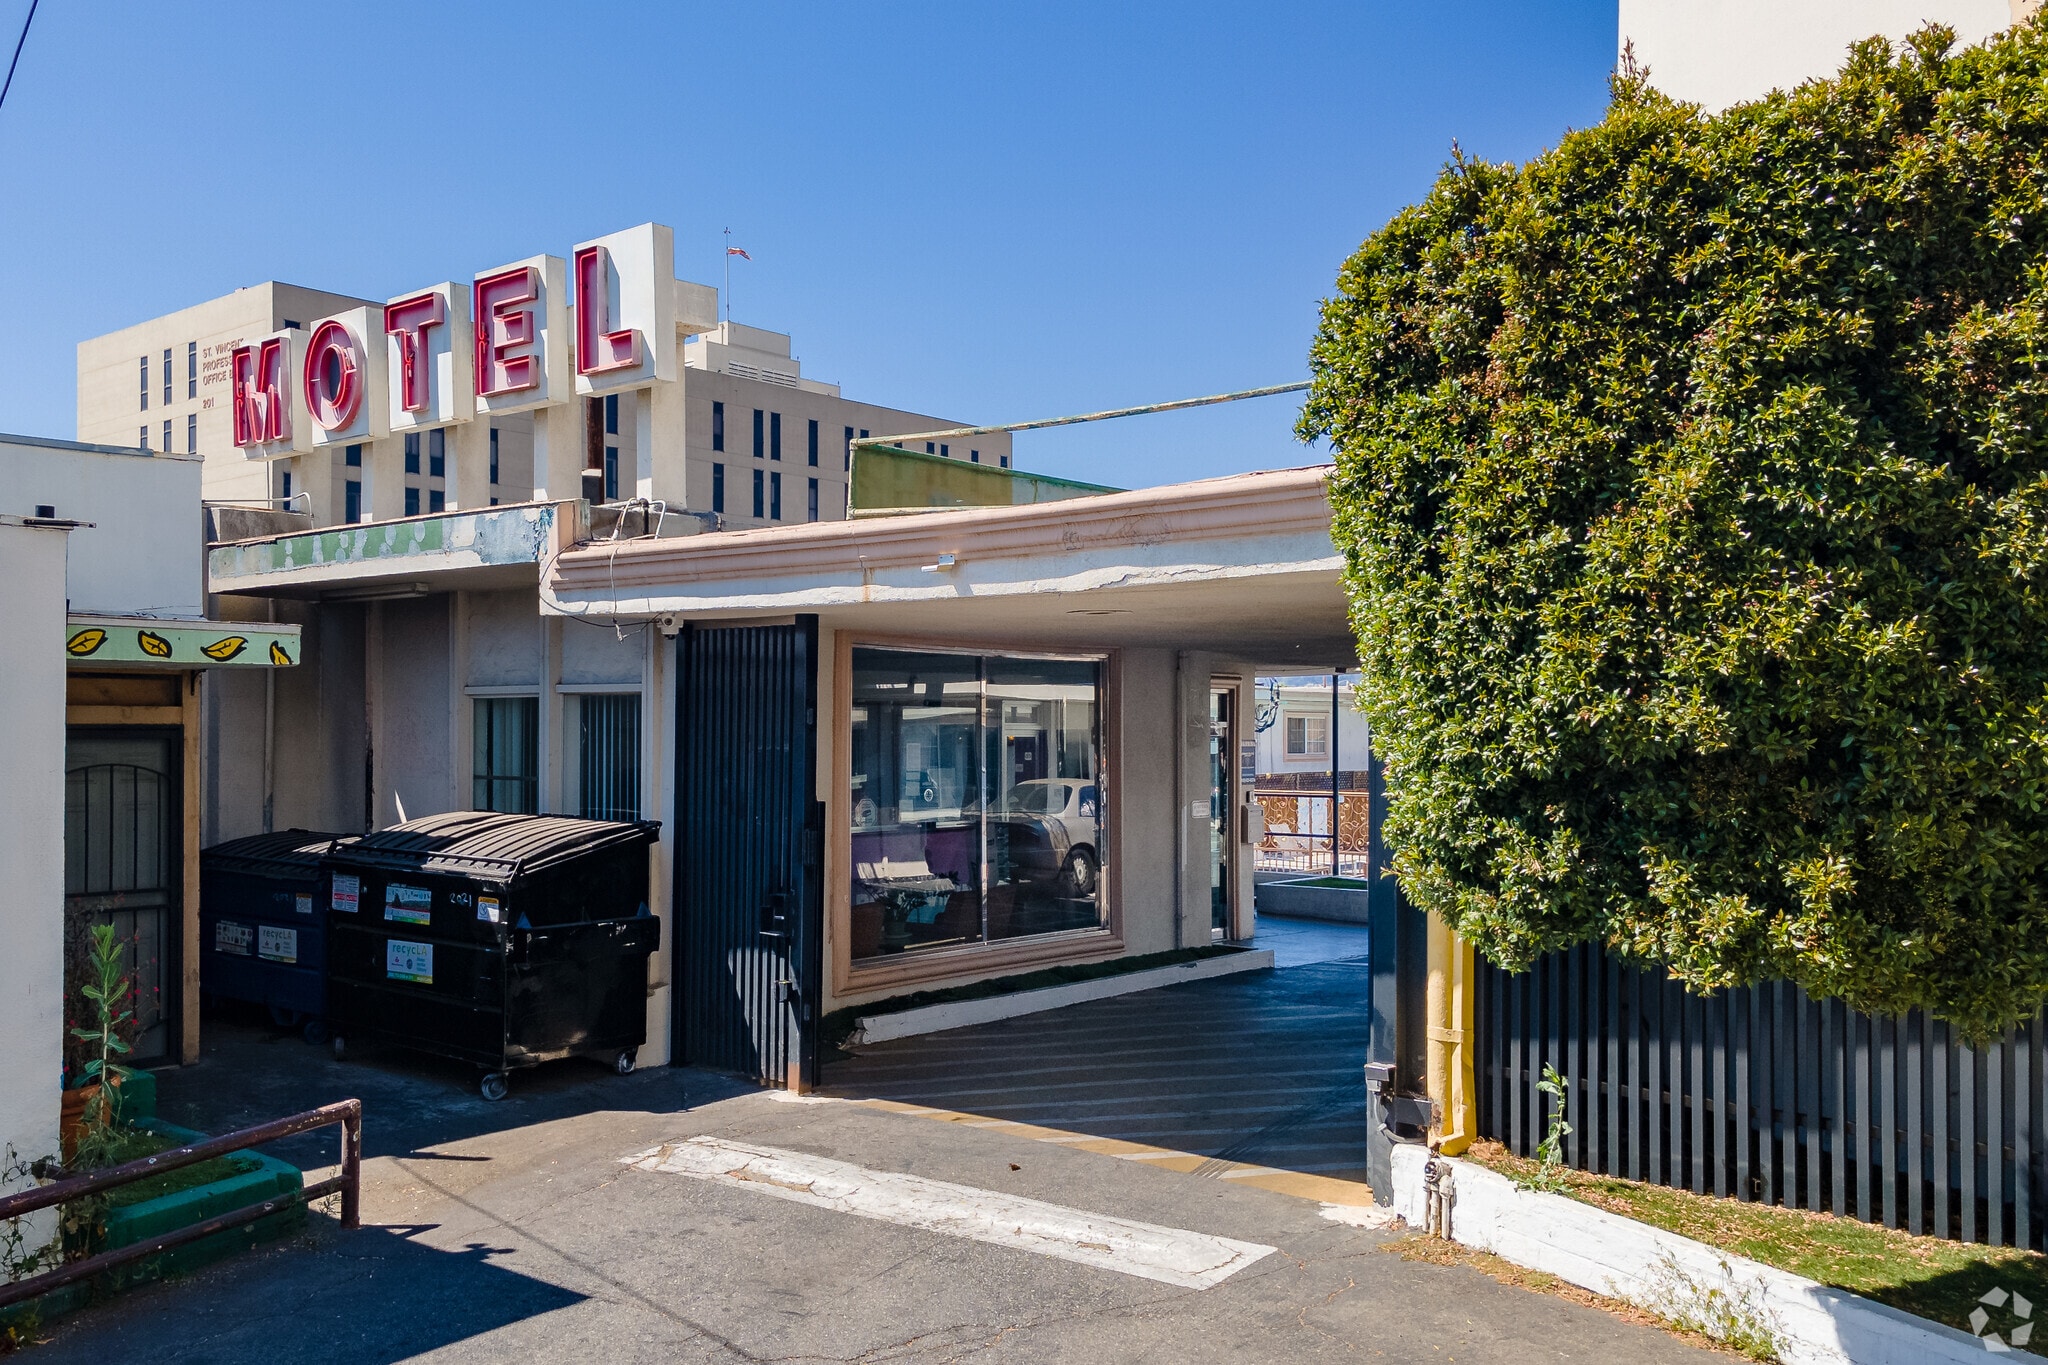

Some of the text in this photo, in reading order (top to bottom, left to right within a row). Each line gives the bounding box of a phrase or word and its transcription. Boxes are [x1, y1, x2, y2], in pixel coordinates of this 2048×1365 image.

[203, 348, 212, 358] ST.
[233, 245, 643, 448] MOTEL
[203, 356, 232, 372] PROFESS
[203, 371, 226, 385] OFFICE
[203, 398, 214, 409] 201
[392, 944, 428, 957] recycLA
